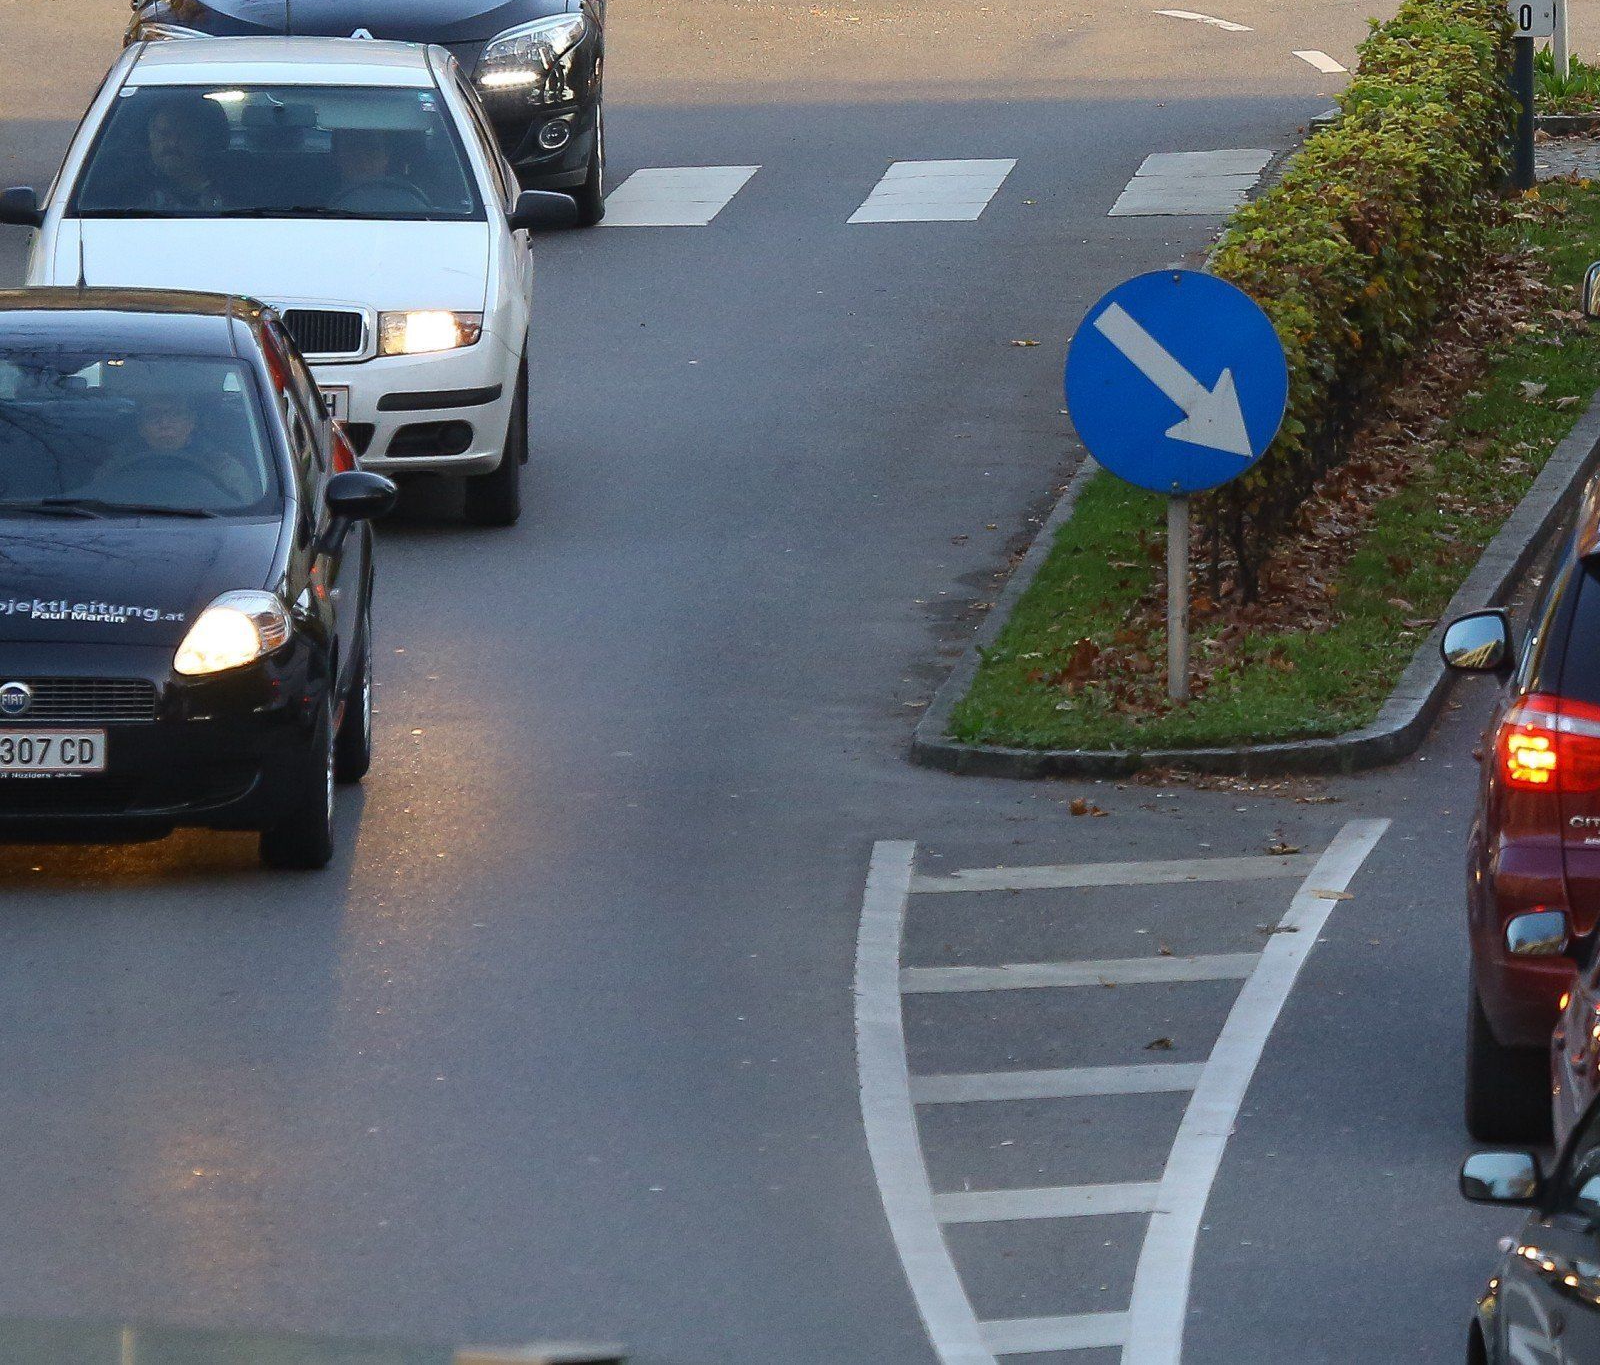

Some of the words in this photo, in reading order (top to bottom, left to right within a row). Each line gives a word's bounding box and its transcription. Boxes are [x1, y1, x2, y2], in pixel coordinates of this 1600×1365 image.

[31, 611, 65, 621] Paul
[71, 611, 126, 623] Martin
[1, 693, 25, 706] FIAT
[0, 738, 52, 765] 307
[60, 738, 94, 765] CD
